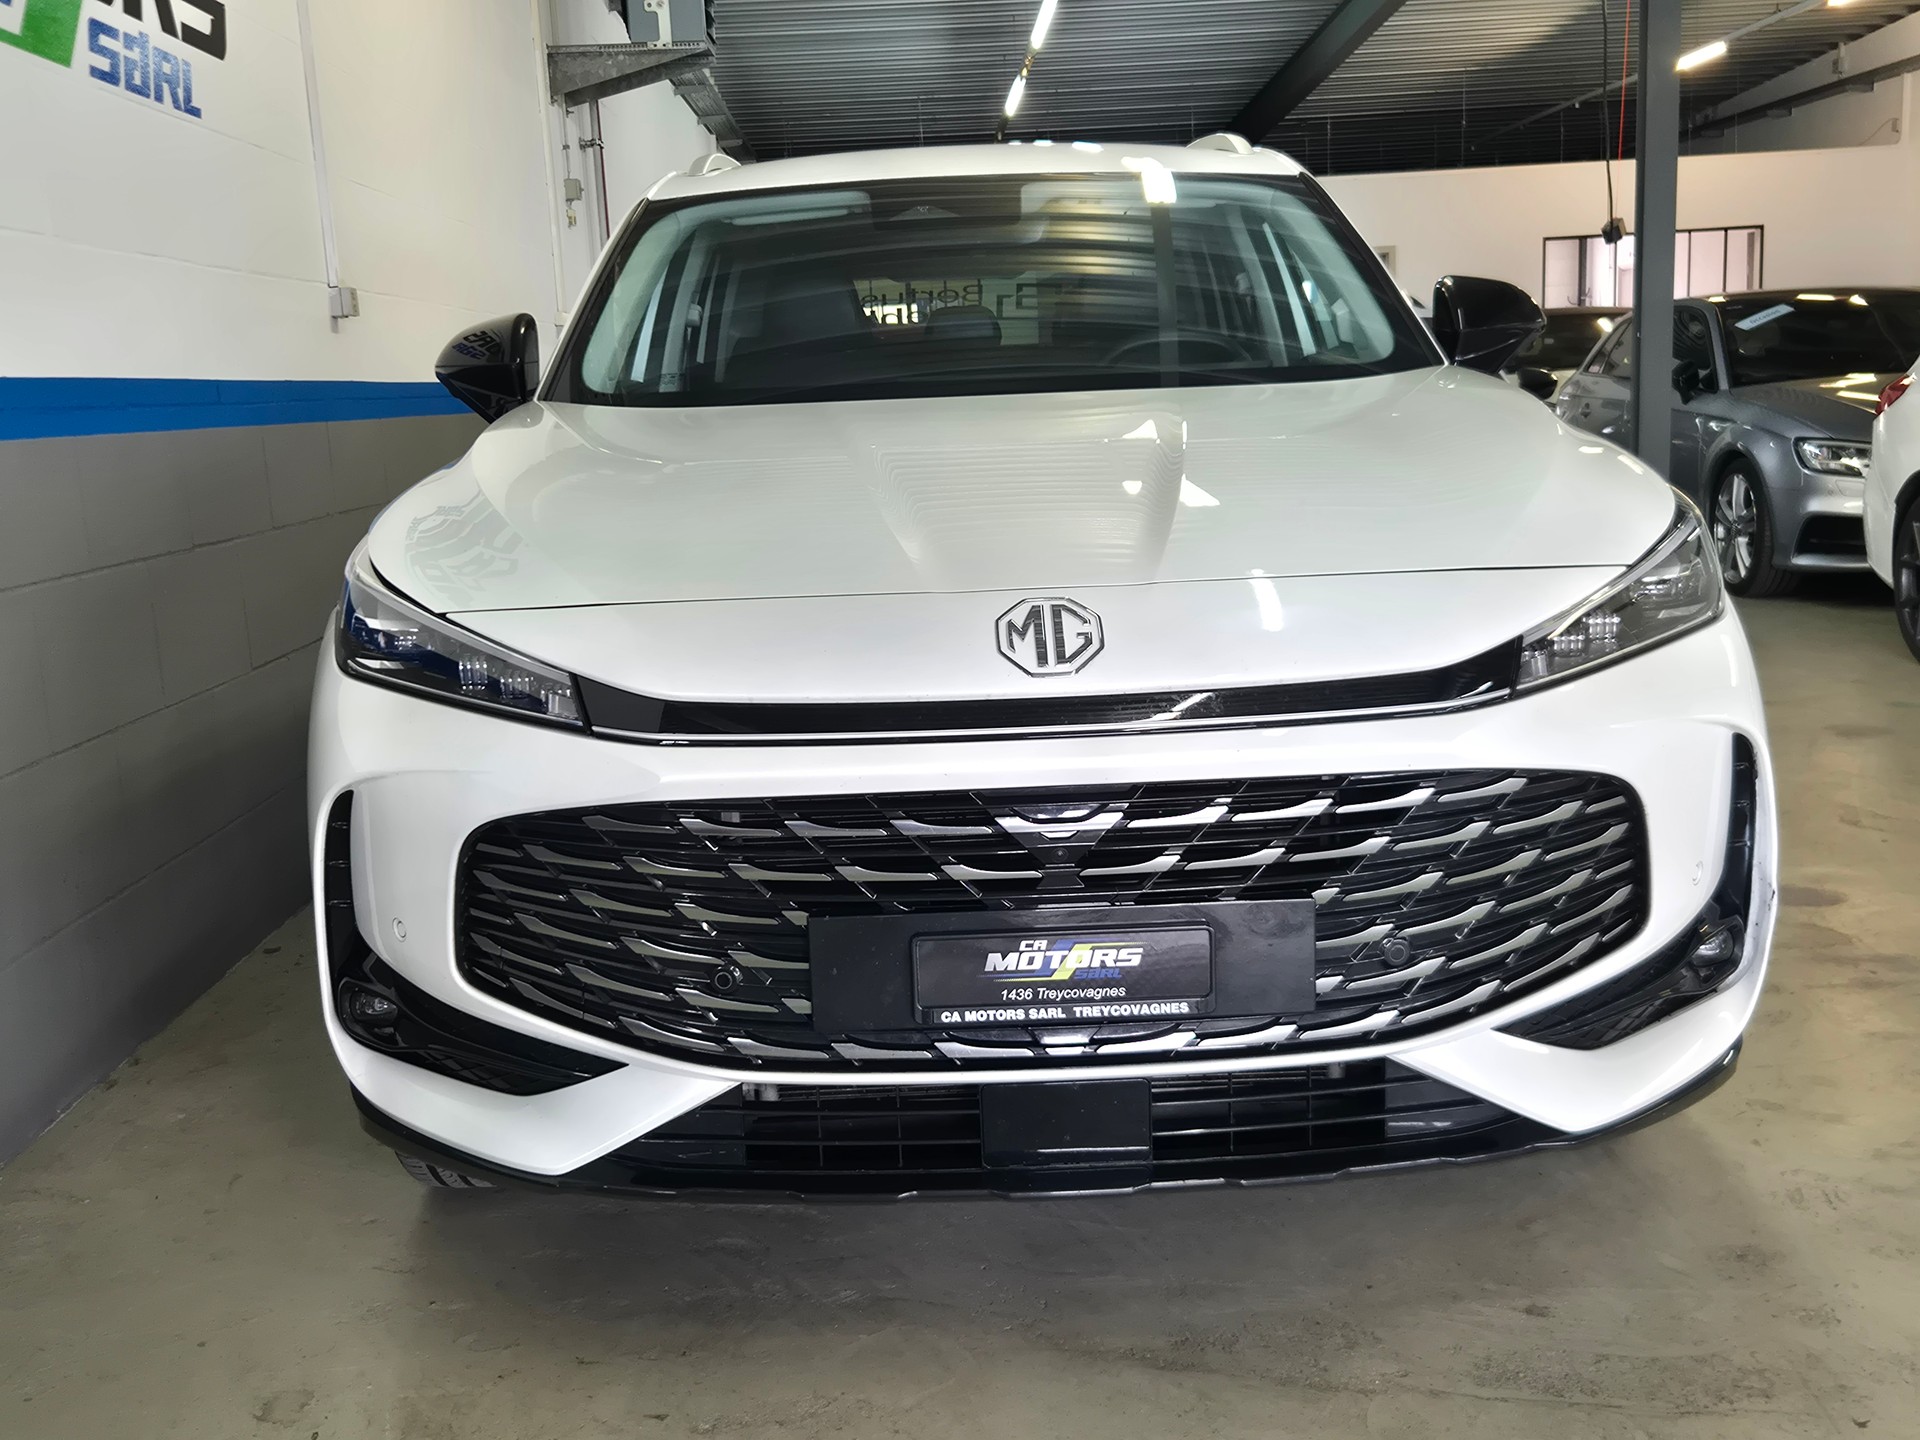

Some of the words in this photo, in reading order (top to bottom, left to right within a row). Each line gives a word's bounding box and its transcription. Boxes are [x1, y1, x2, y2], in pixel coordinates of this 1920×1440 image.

[1006, 603, 1093, 668] MG
[1019, 939, 1048, 951] CA
[984, 947, 1144, 972] MOTORS
[1000, 987, 1033, 1001] 1436
[1036, 986, 1127, 1002] Treycovagnes
[940, 1010, 961, 1023] CA
[964, 1008, 1026, 1022] MOTORS
[1028, 1007, 1066, 1020] SARL
[1072, 1001, 1190, 1018] TREYCOVAGNES
